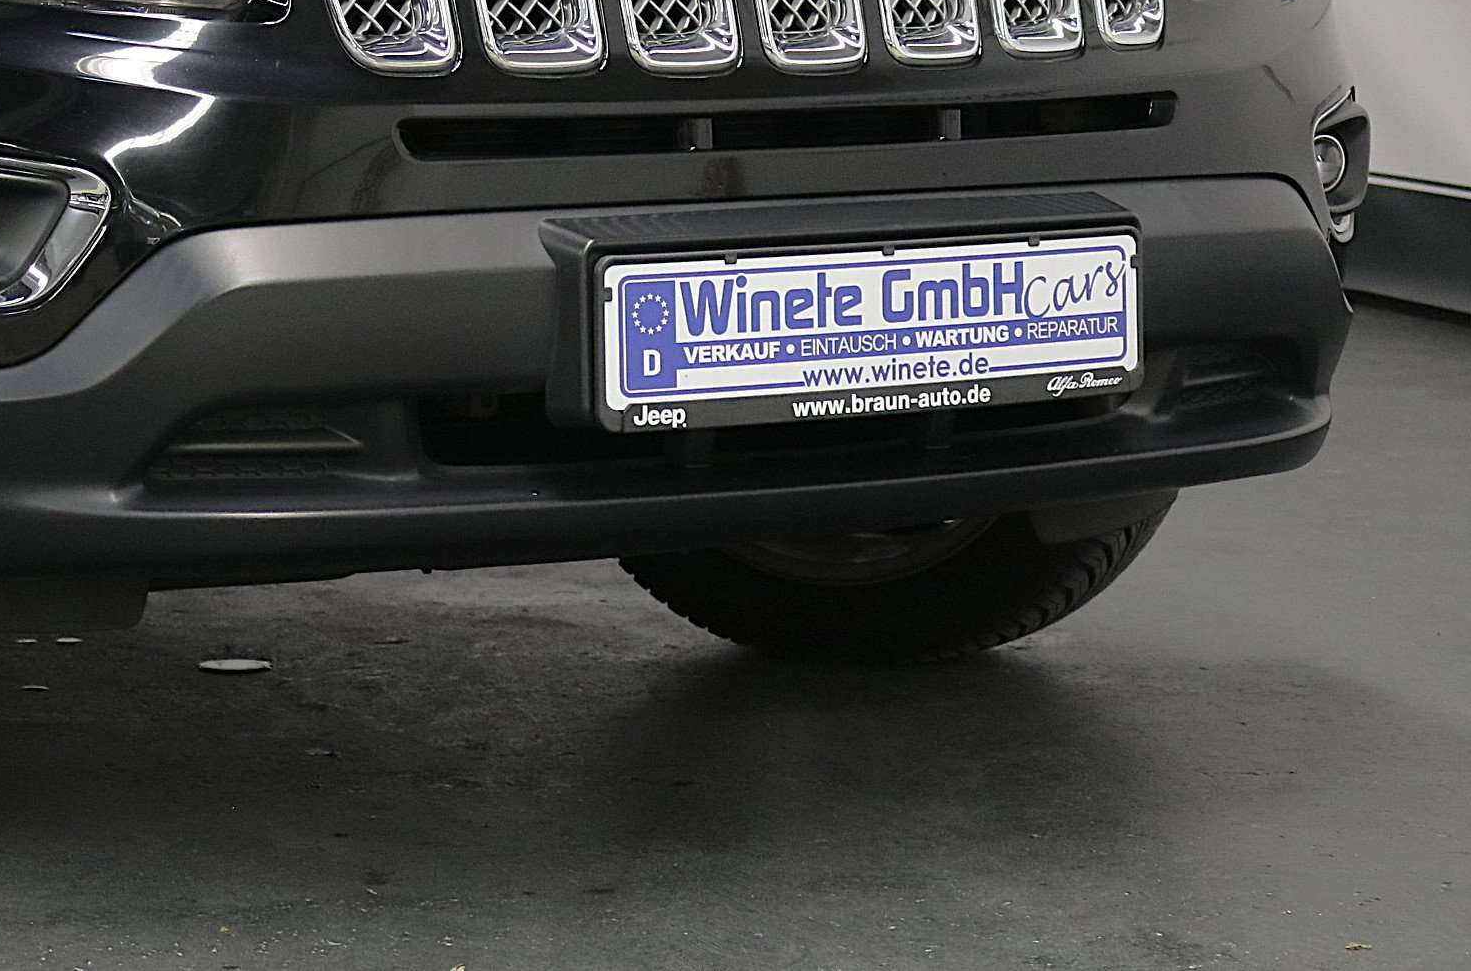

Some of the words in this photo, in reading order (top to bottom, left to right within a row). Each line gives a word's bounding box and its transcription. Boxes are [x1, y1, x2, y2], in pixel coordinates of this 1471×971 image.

[680, 272, 863, 336] Winete
[882, 261, 1024, 323] GmbH
[683, 340, 781, 365] VERKAUF
[801, 333, 897, 357] EINTAUSCH
[915, 324, 1010, 348] WARTUNG
[1027, 316, 1119, 340] REPARATUR
[642, 348, 662, 377] D
[802, 352, 990, 387] www.winete.de
[792, 384, 992, 418] www.braun-auto.de
[1046, 375, 1079, 398] Alfa
[1078, 372, 1123, 390] Romeo
[632, 405, 687, 429] Jeep
